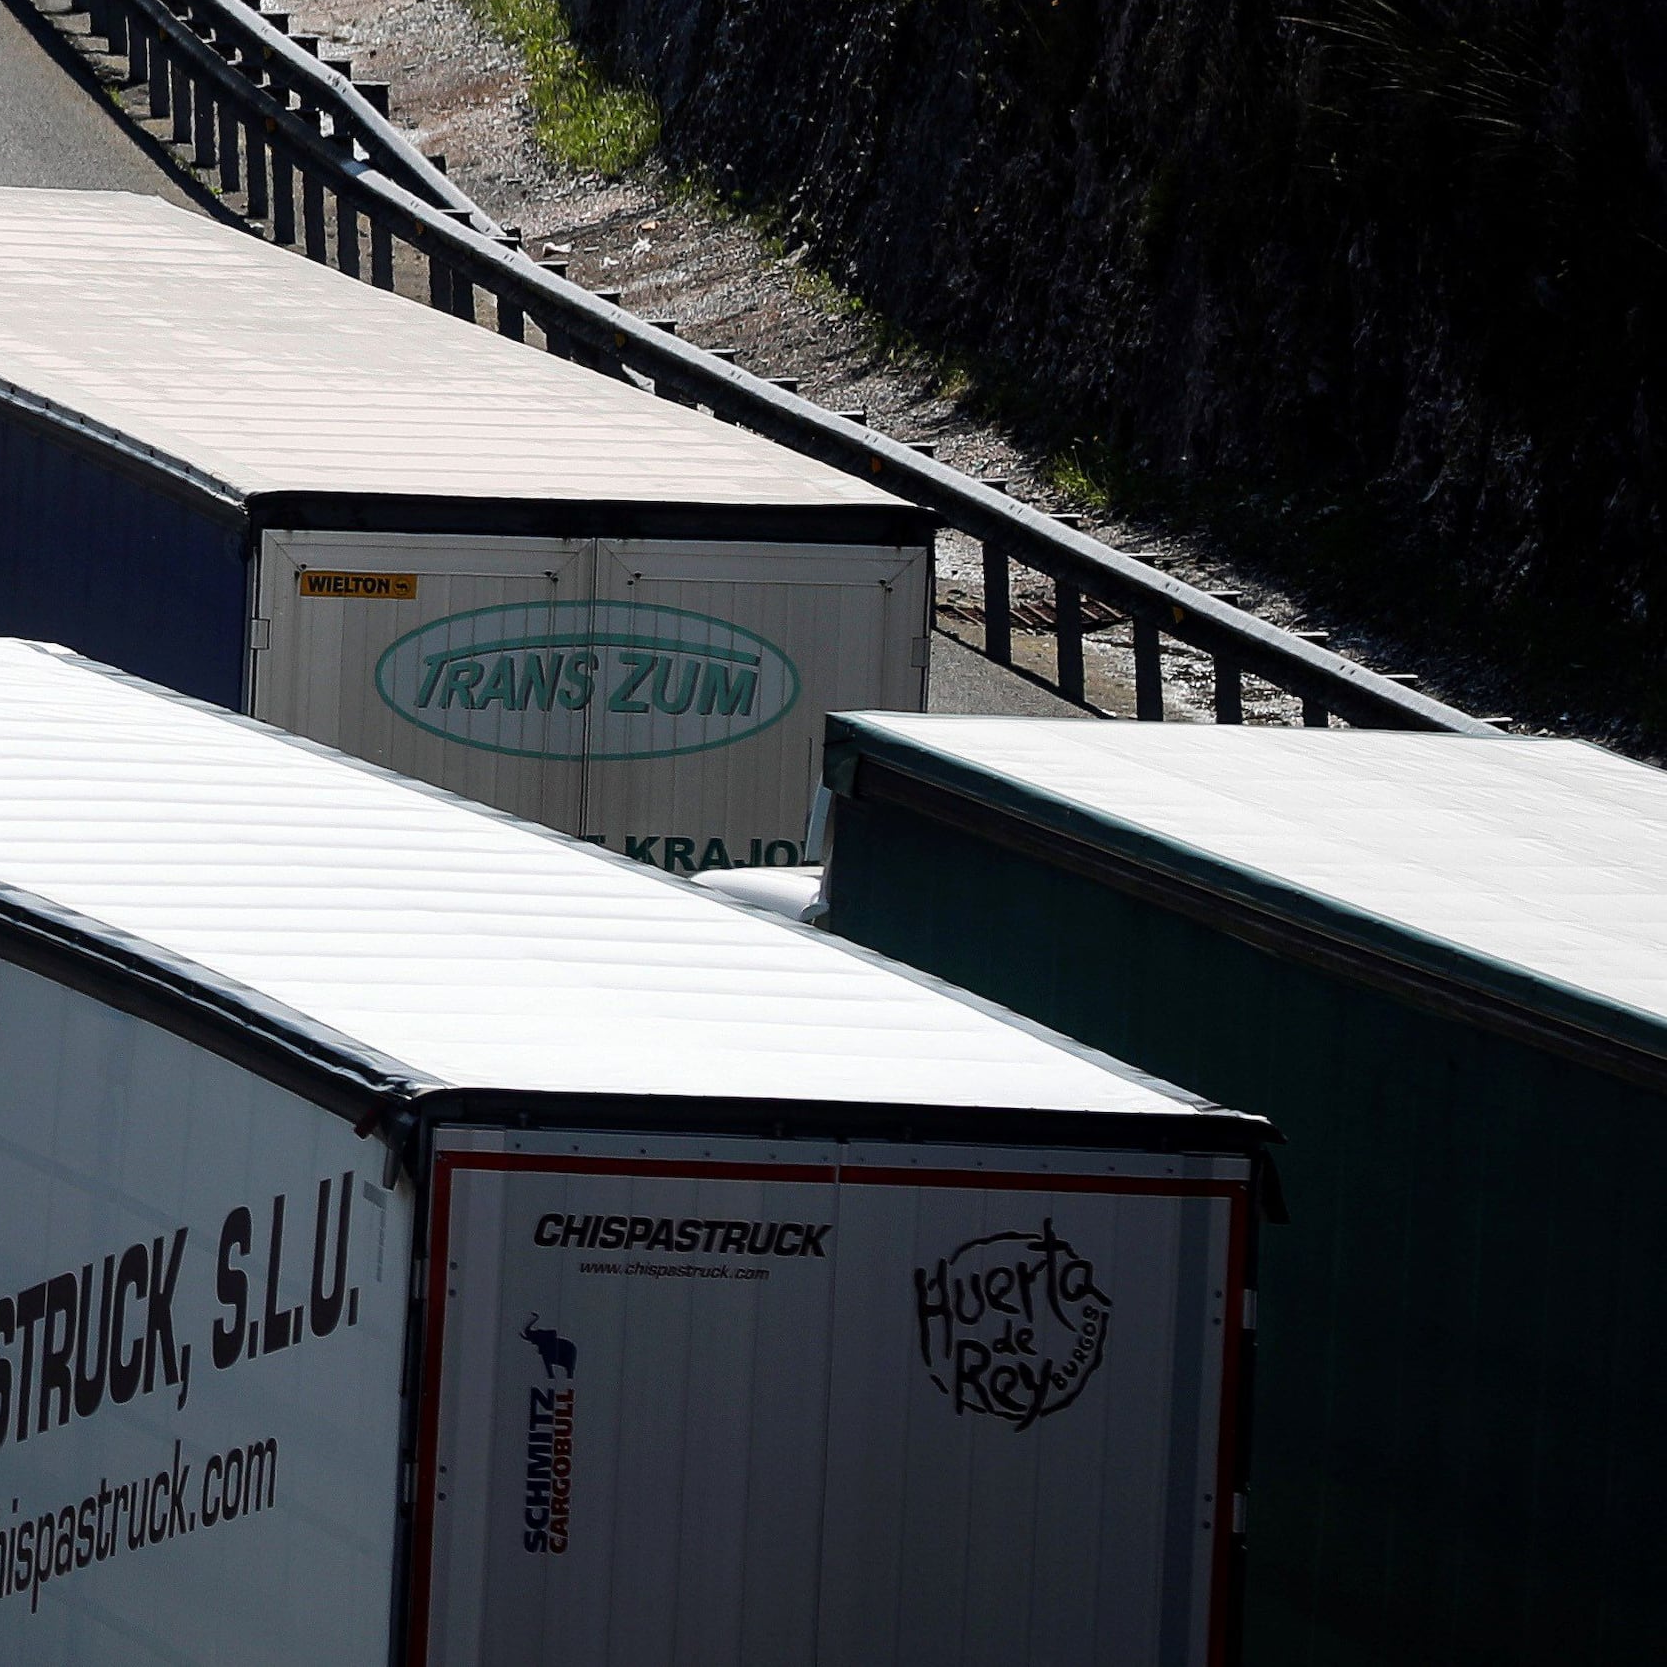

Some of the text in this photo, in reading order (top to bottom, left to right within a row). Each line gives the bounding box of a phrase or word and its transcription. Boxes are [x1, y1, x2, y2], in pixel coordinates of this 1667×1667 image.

[307, 575, 391, 596] WIELTON
[413, 650, 762, 717] TRANS ZUM
[625, 835, 808, 872] KRAJO
[212, 1170, 360, 1371] S.L.U.
[533, 1212, 834, 1257] CHISPASTRUCK
[579, 1260, 770, 1281] www.chispastruck.com
[915, 1217, 1113, 1368] Huerta
[993, 1319, 1038, 1356] de
[1050, 1305, 1100, 1391] BURGOS
[956, 1339, 1053, 1434] Rey
[524, 1387, 555, 1553] SCHMITZ
[549, 1388, 575, 1555] CARGOBULL
